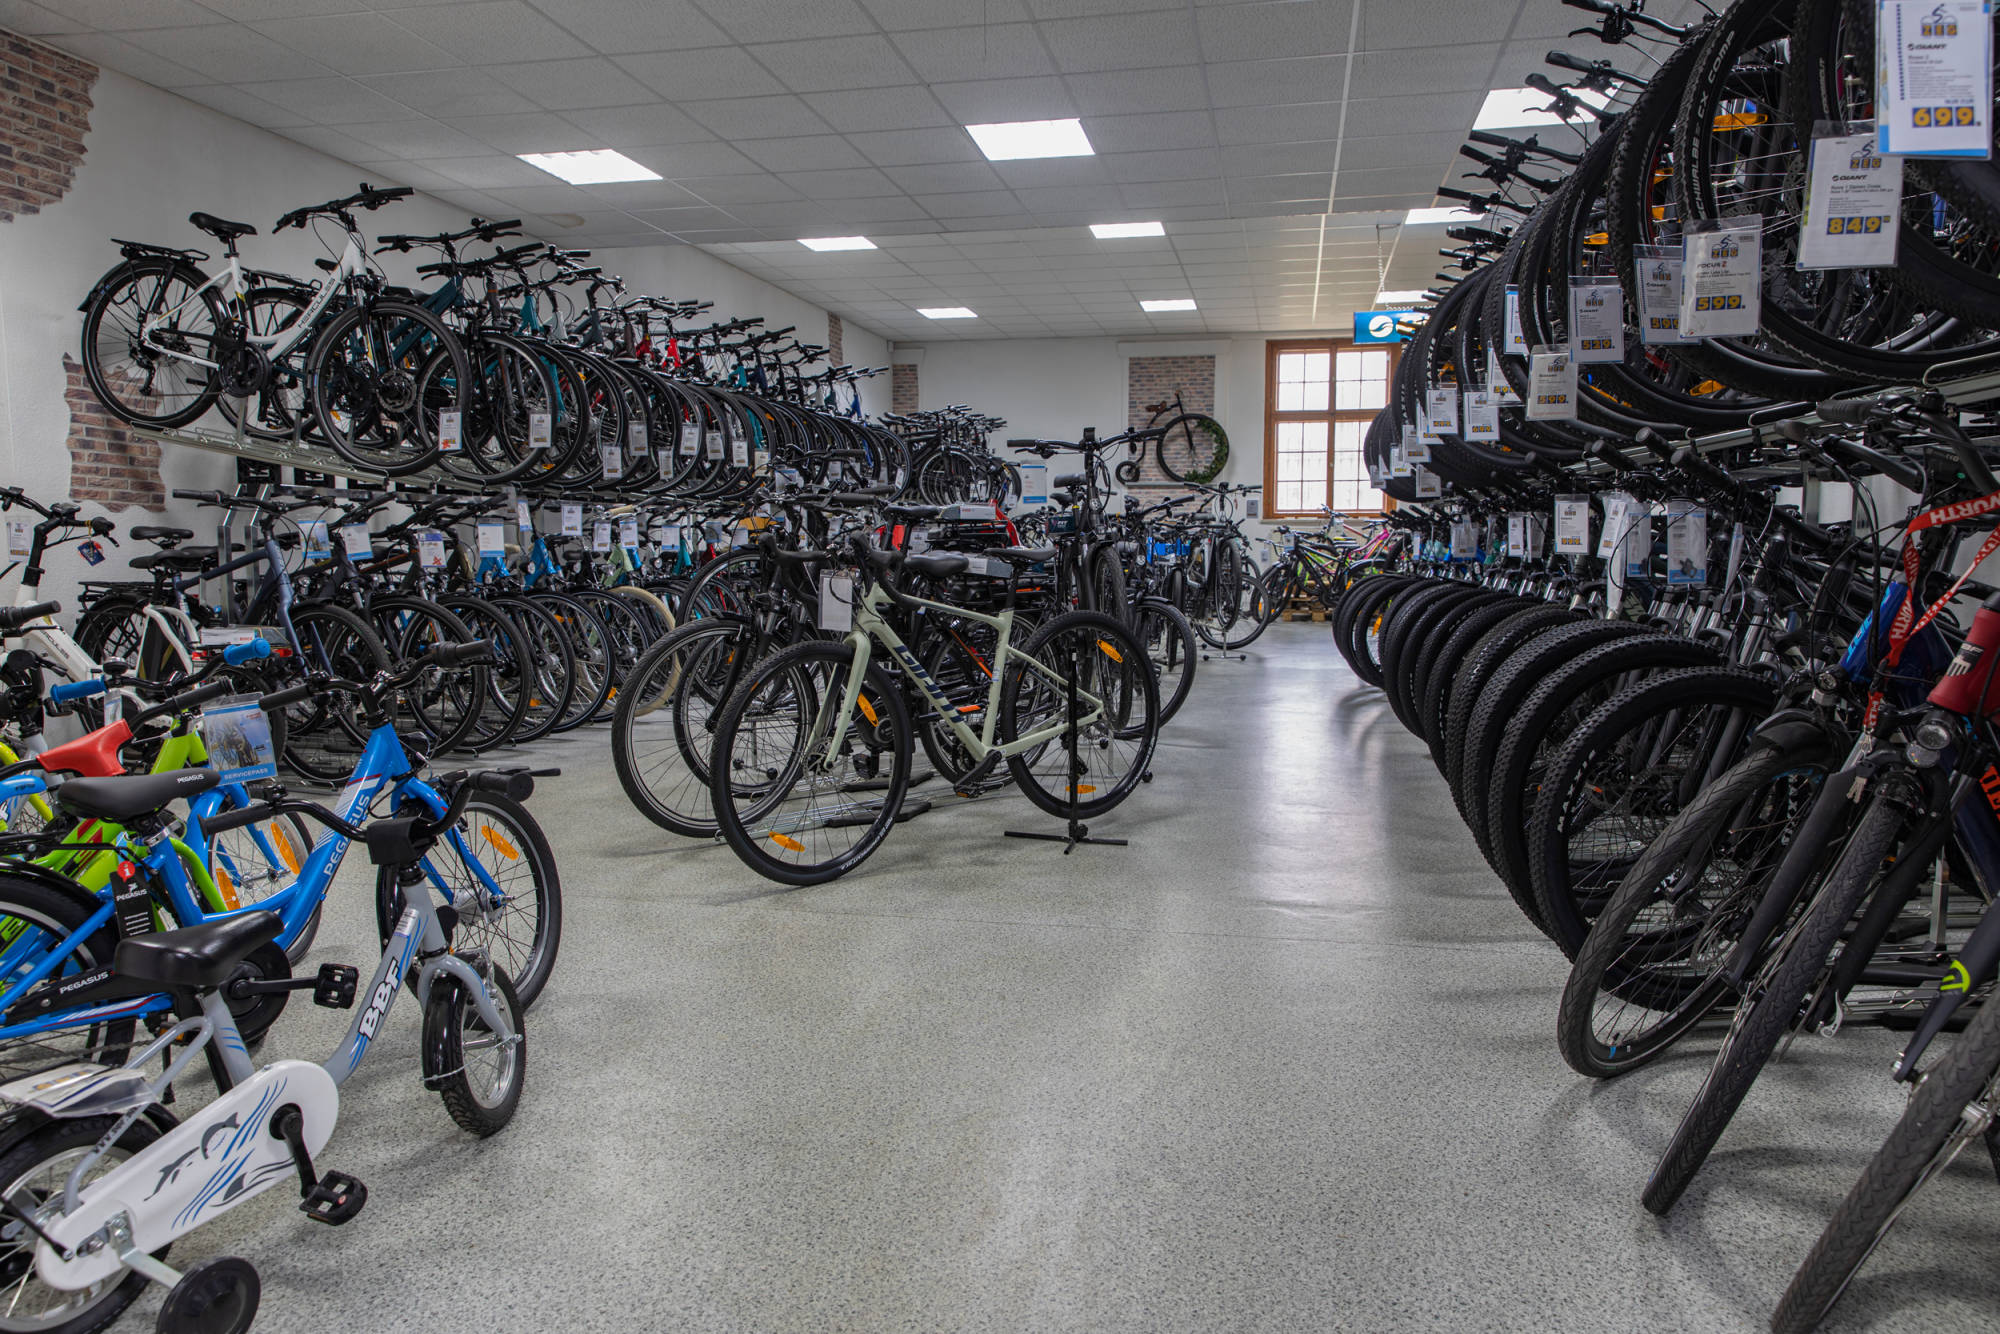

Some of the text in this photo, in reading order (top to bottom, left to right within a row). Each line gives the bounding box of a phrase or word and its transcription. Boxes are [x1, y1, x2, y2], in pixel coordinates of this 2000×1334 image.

[1708, 30, 1735, 84] COMP
[176, 774, 204, 784] PEGASUS
[224, 767, 268, 780] SERVICEPASS
[116, 889, 148, 901] PEGASUS
[59, 971, 109, 994] PEGASUS
[358, 956, 402, 1040] BBF
